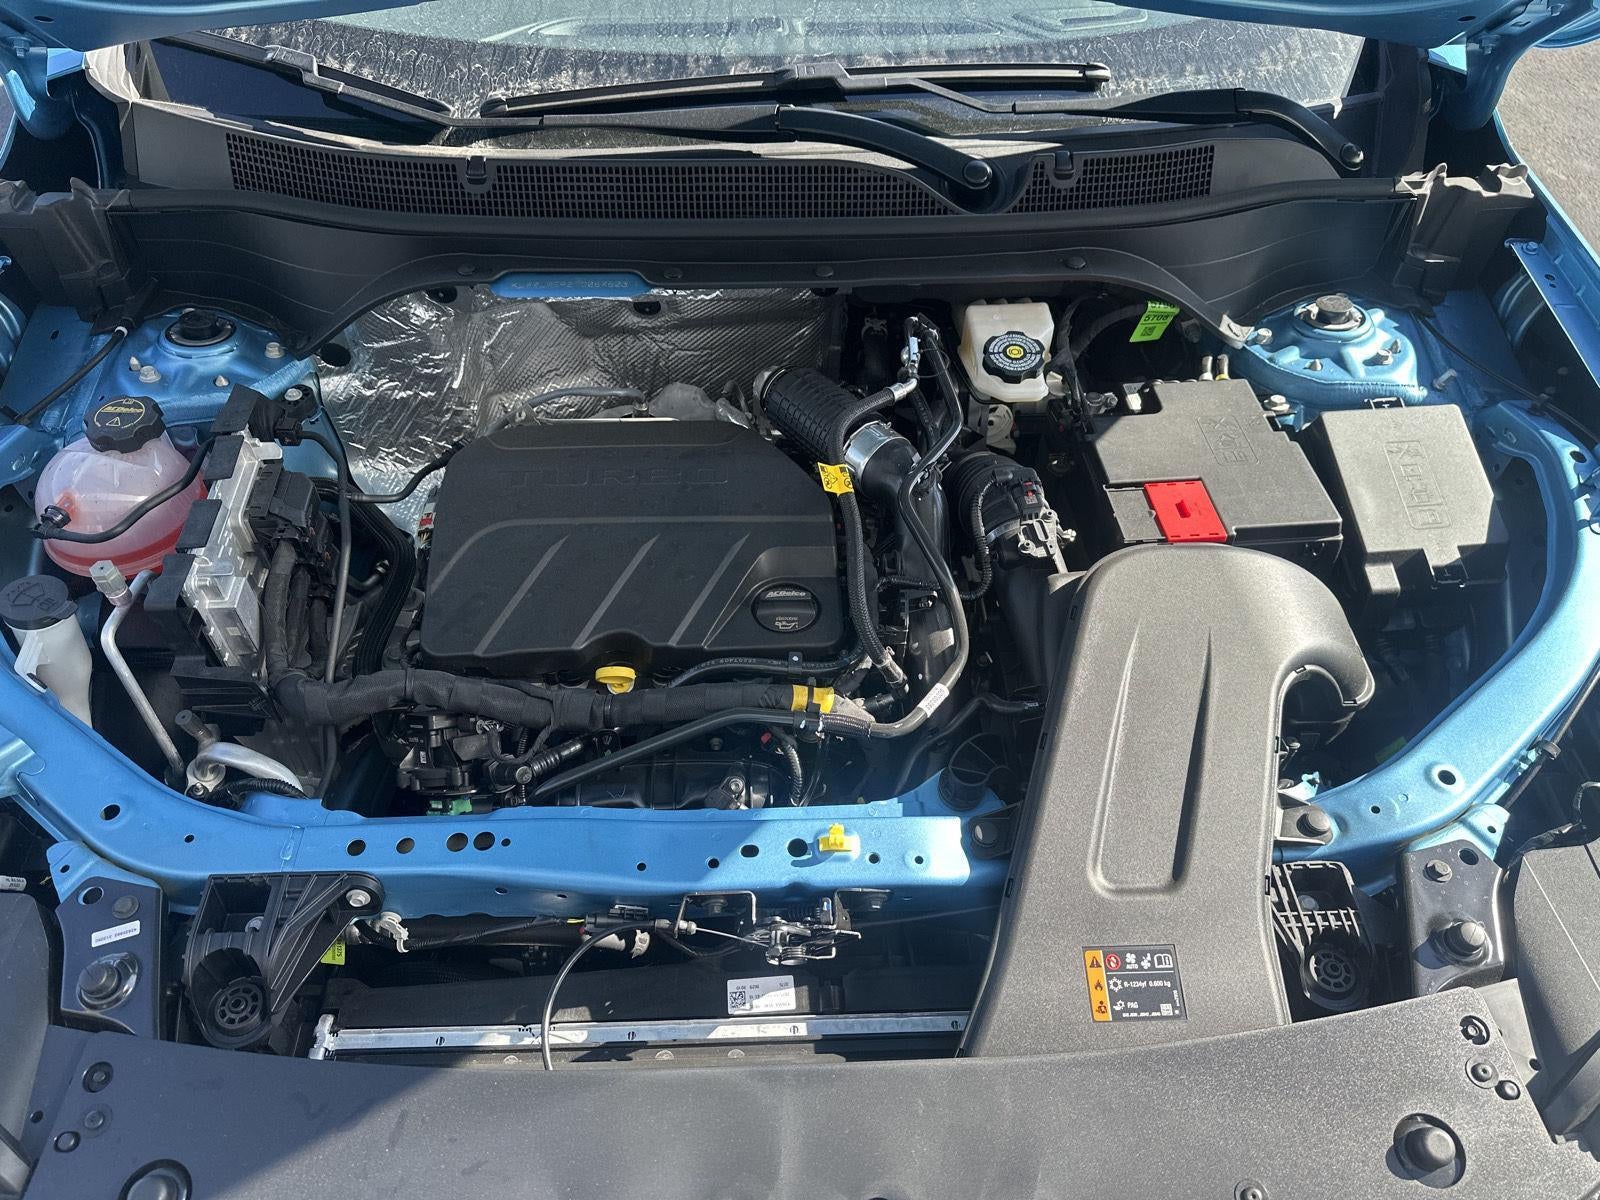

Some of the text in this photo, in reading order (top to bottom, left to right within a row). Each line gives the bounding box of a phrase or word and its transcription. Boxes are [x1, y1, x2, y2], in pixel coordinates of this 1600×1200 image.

[101, 405, 144, 414] ACDelco
[497, 468, 728, 488] TURBO
[765, 590, 807, 599] ACDelco
[1164, 980, 1171, 988] kg
